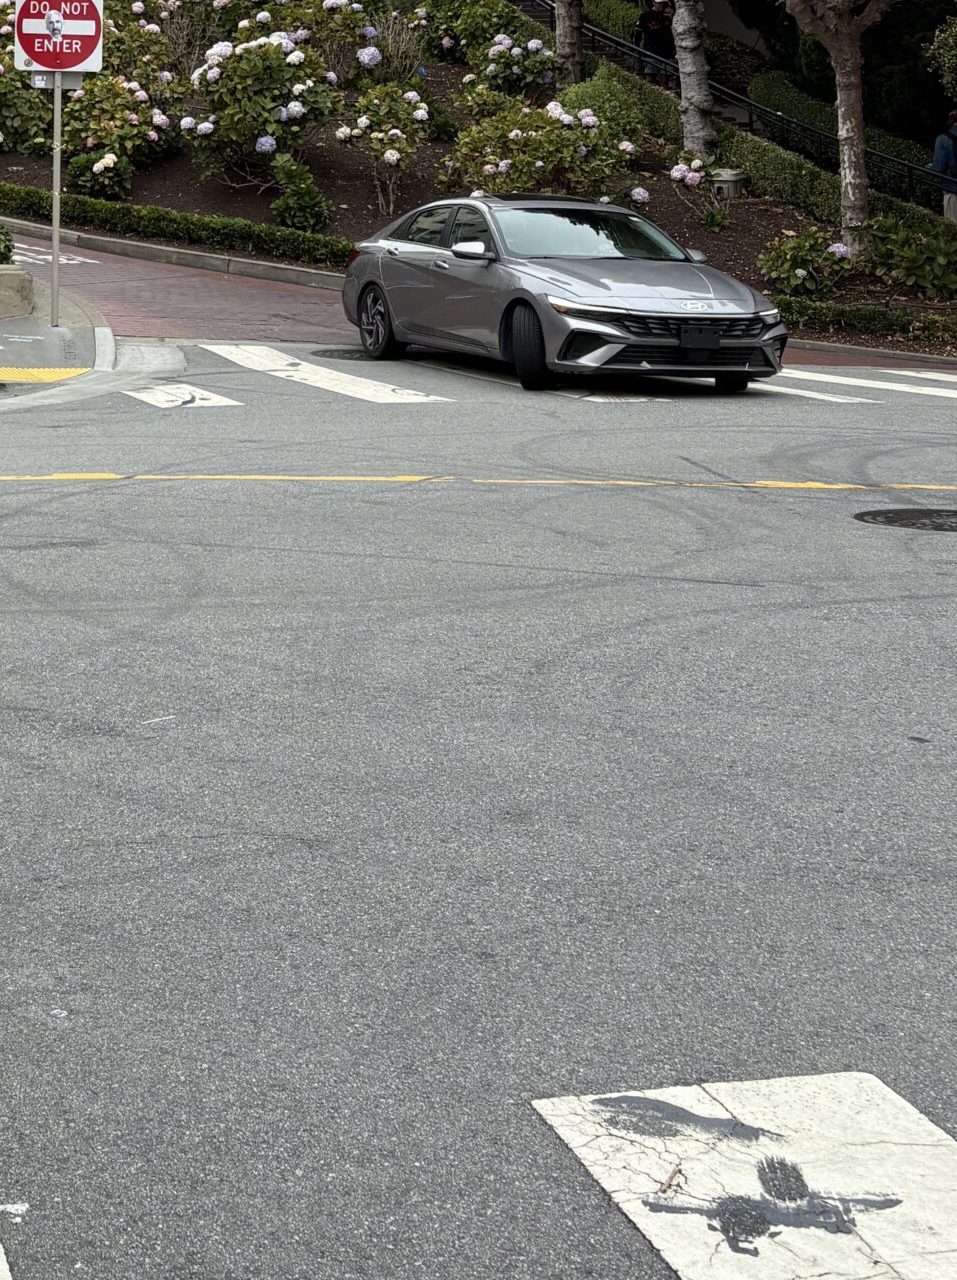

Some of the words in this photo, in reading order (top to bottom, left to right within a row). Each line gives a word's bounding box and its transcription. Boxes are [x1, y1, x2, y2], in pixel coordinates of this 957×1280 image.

[30, 0, 50, 14] DO
[60, 1, 89, 15] NOT
[34, 38, 82, 53] ENTER
